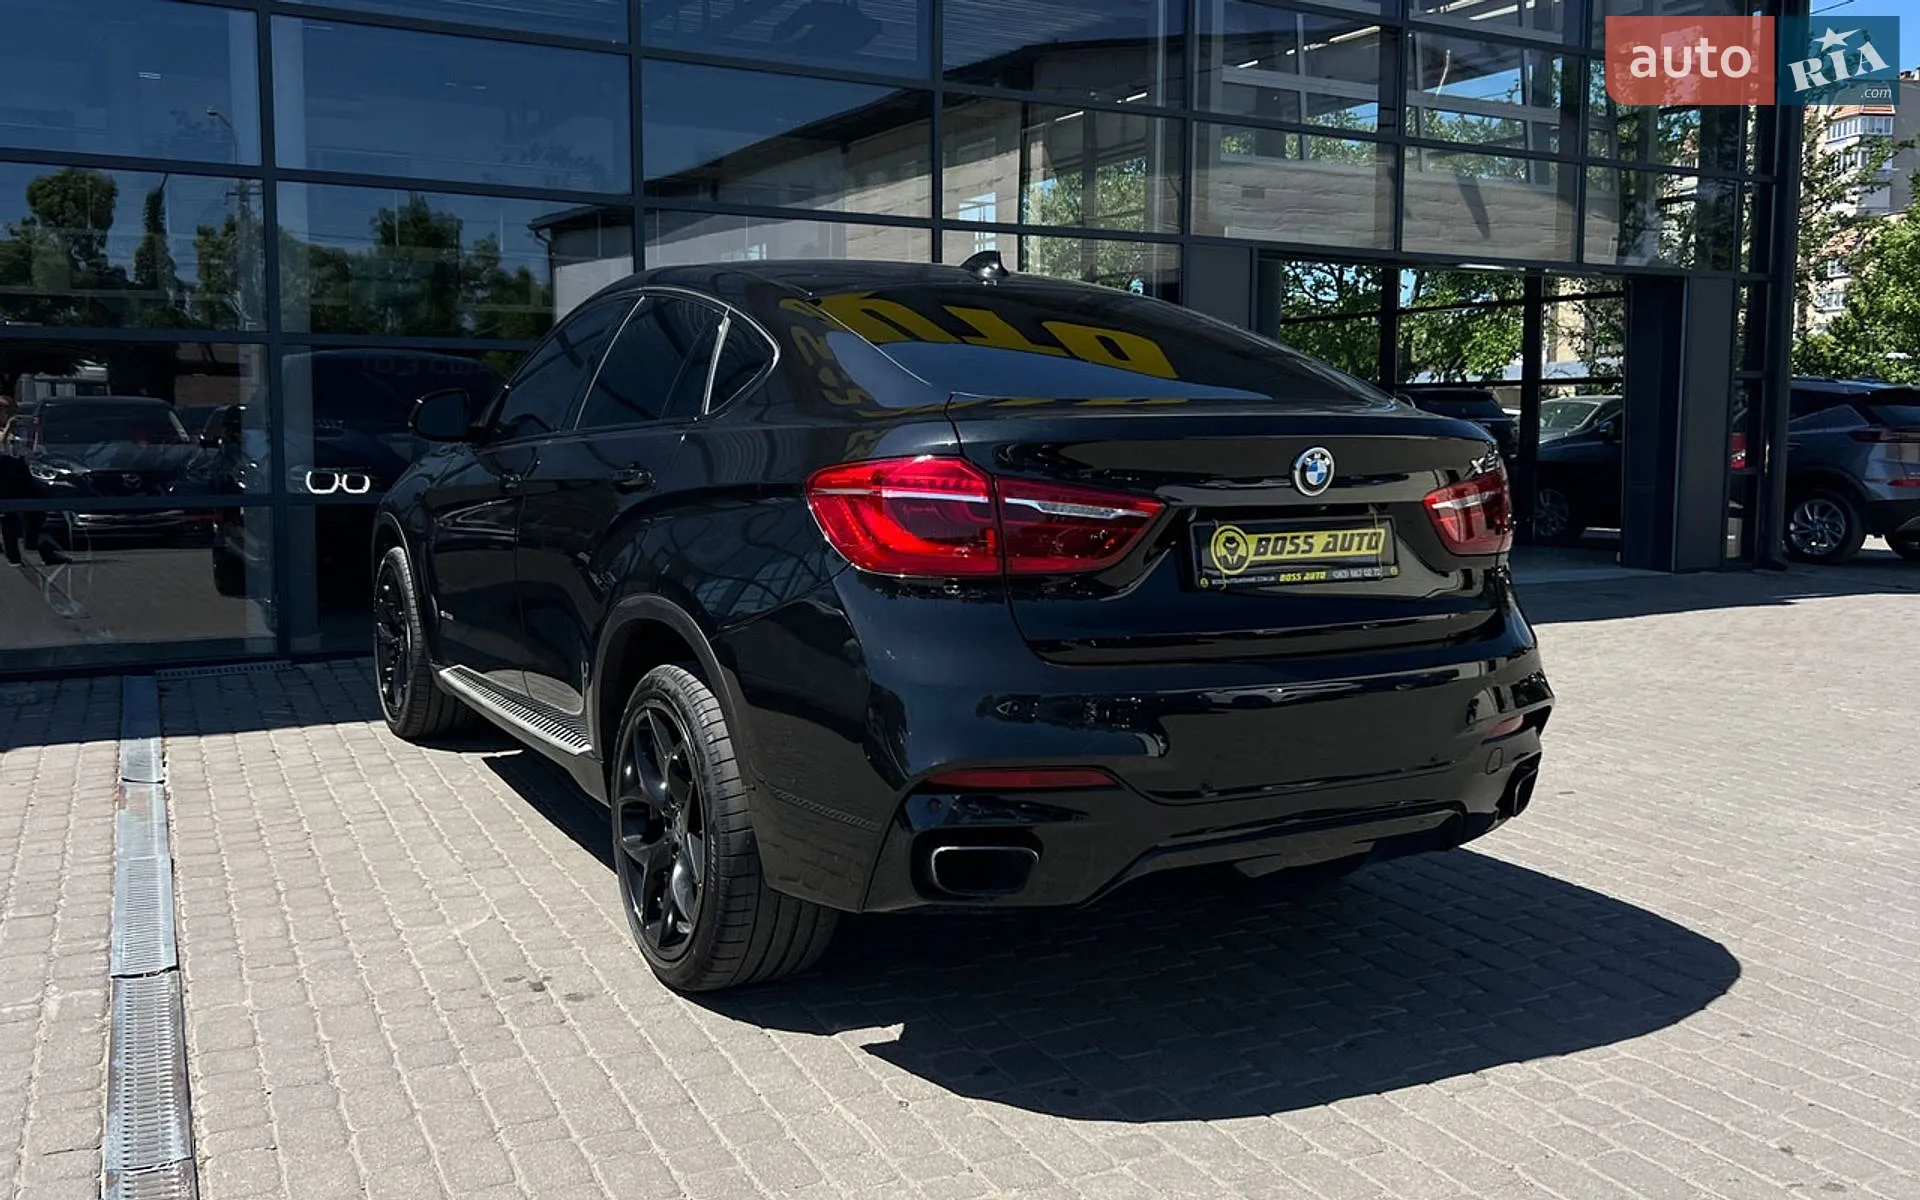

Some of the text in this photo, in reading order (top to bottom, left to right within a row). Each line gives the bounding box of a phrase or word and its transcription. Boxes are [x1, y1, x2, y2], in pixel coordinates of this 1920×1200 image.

[1253, 531, 1383, 556] BOSS AUTO
[1279, 573, 1301, 582] BOSS
[1304, 571, 1326, 580] AUTO
